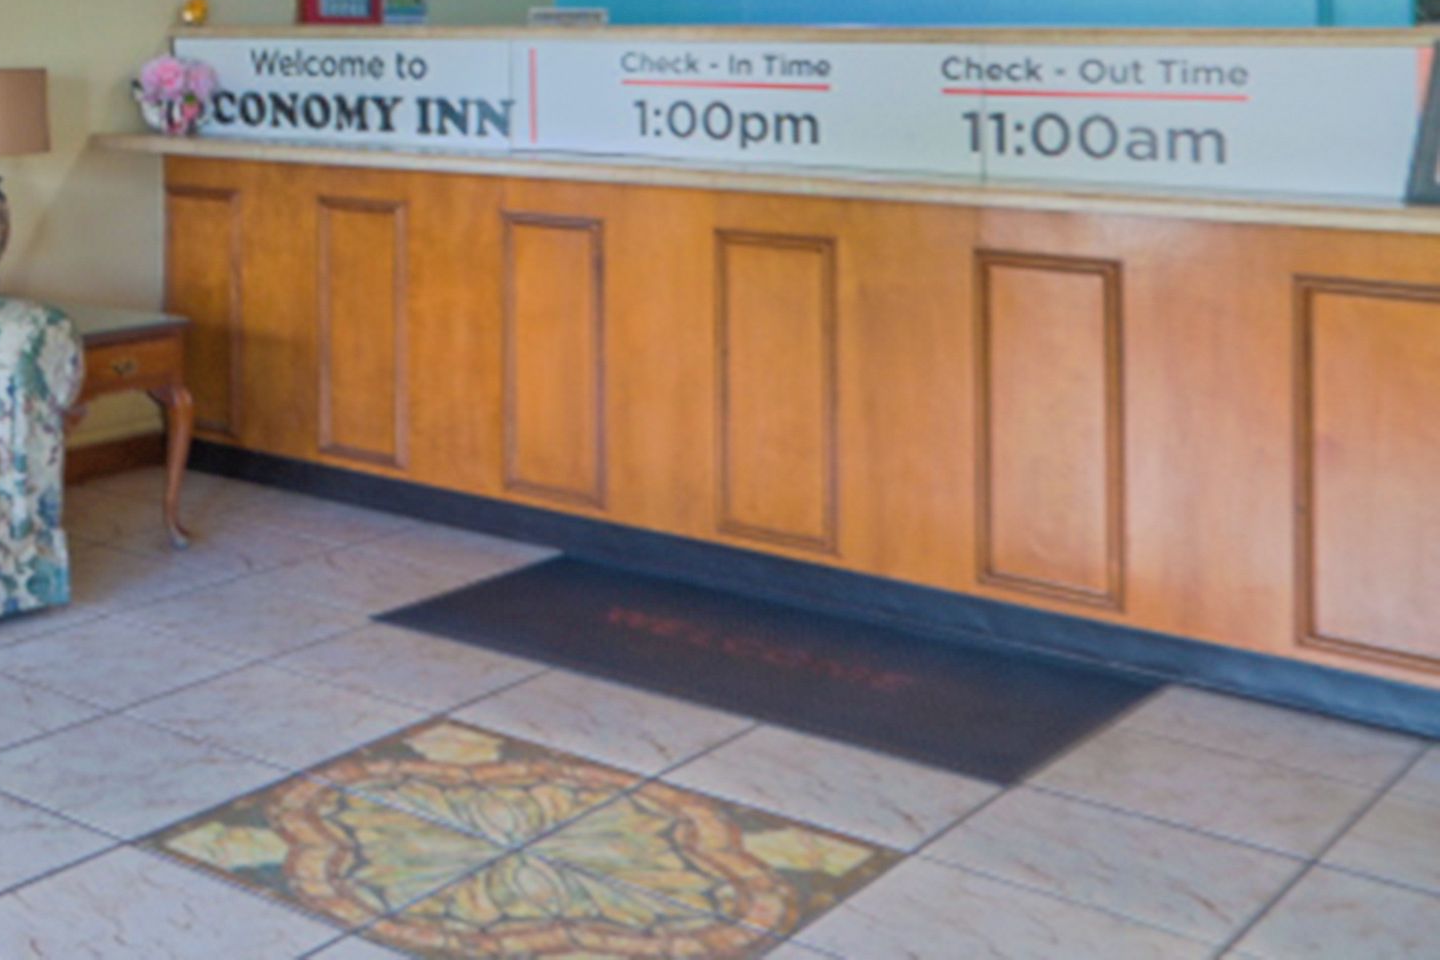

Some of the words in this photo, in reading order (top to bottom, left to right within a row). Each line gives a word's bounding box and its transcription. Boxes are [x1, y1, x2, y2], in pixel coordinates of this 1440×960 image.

[251, 48, 384, 79] Welcome
[395, 52, 429, 81] to
[621, 52, 699, 74] Check
[729, 54, 753, 77] In
[763, 55, 832, 78] Time
[941, 55, 1043, 82] Check
[1079, 58, 1145, 85] Out
[1157, 59, 1250, 86] Time
[212, 91, 404, 133] CONOMY
[416, 97, 514, 137] INN
[633, 100, 820, 149] 1:00pm
[962, 110, 1227, 164] 11:00am
